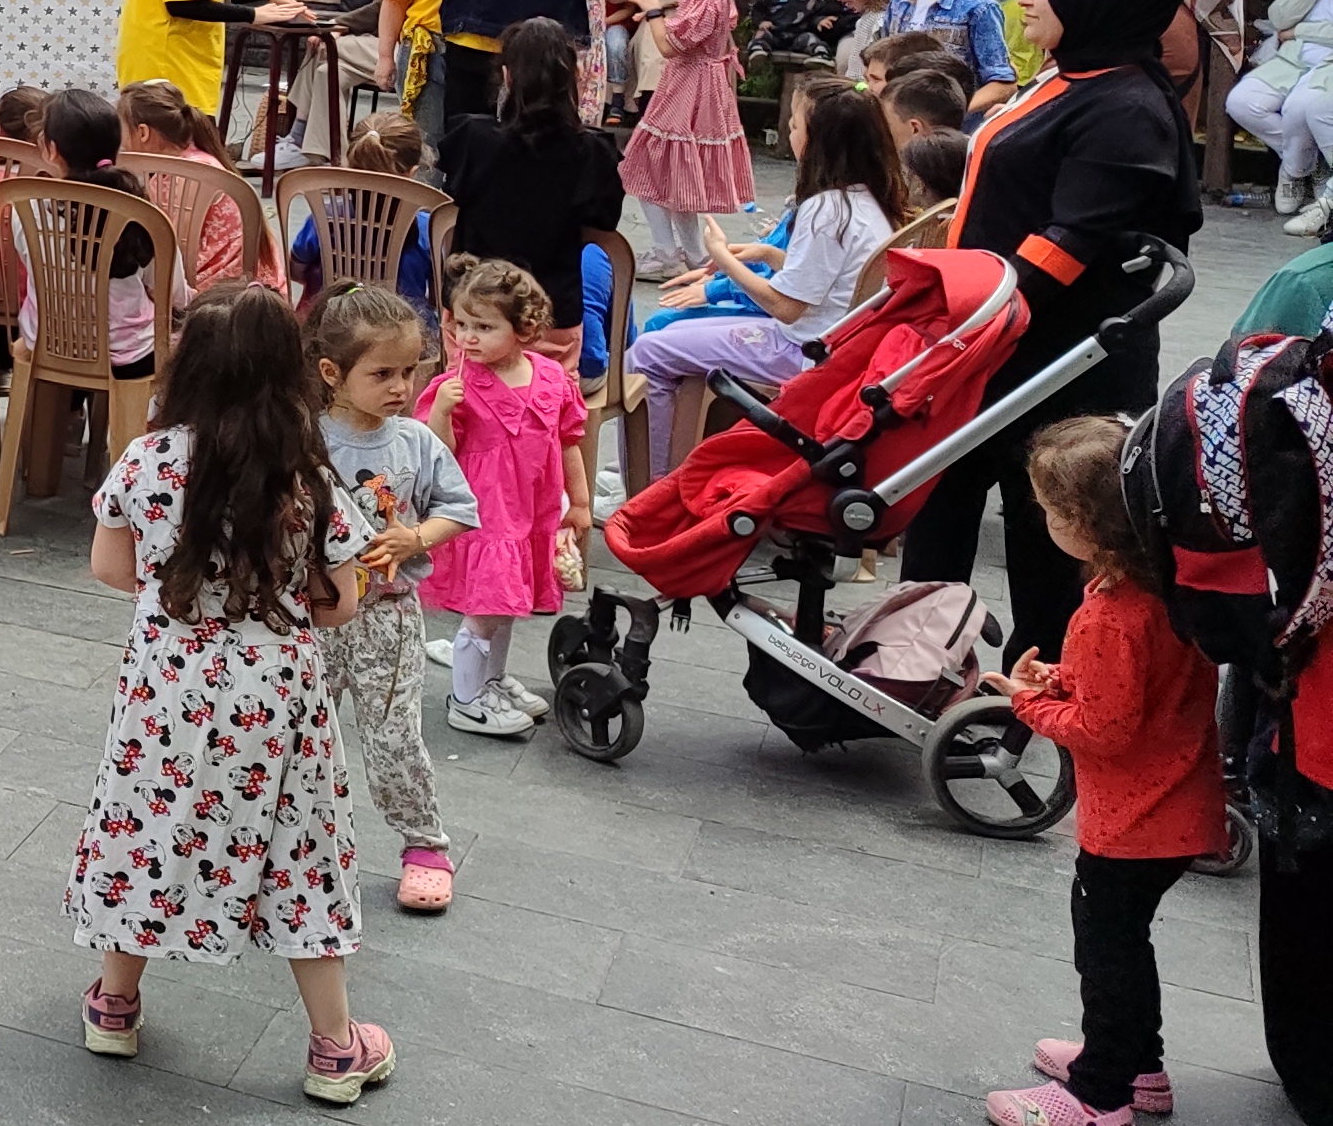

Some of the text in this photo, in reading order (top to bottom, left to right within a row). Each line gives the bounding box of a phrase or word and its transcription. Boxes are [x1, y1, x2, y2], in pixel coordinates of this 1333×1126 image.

[767, 633, 886, 716] baby2go VOLO LX
